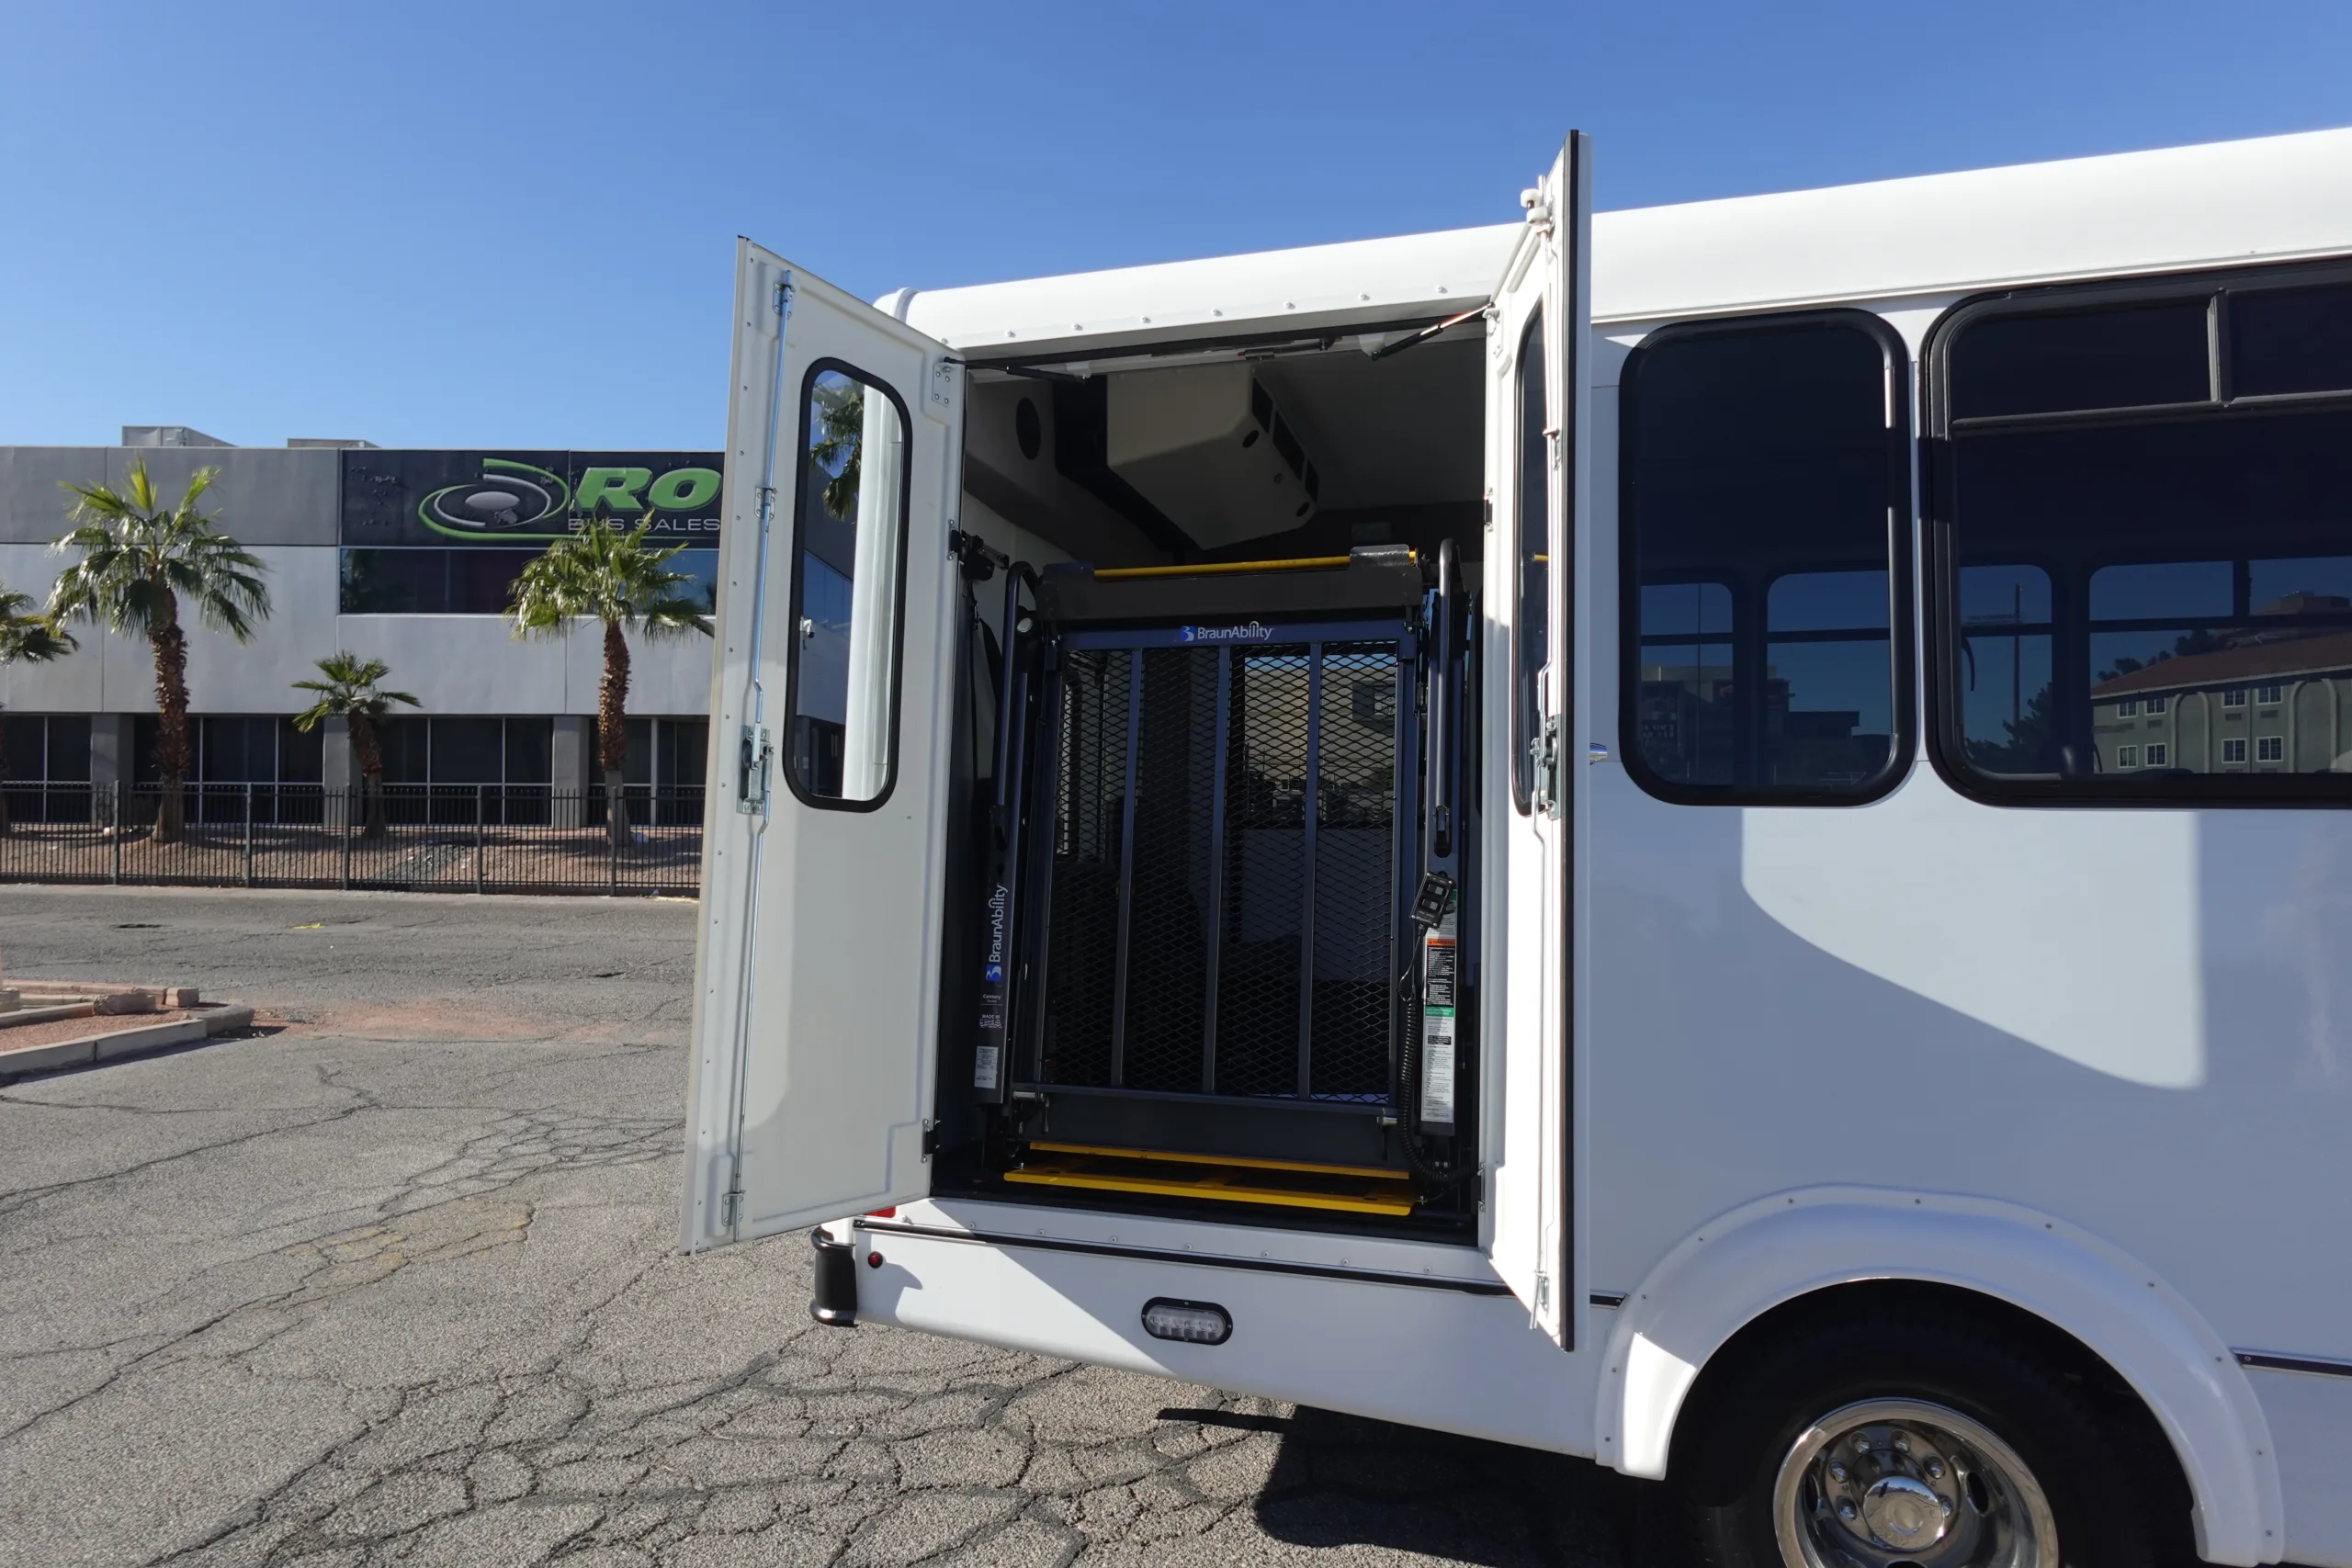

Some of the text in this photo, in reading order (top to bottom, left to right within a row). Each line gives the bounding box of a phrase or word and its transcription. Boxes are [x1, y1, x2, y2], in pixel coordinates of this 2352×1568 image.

[574, 467, 723, 513] RO
[634, 518, 721, 531] SALES
[1197, 622, 1272, 640] BraunAbility
[989, 885, 1008, 963] BraunAbility
